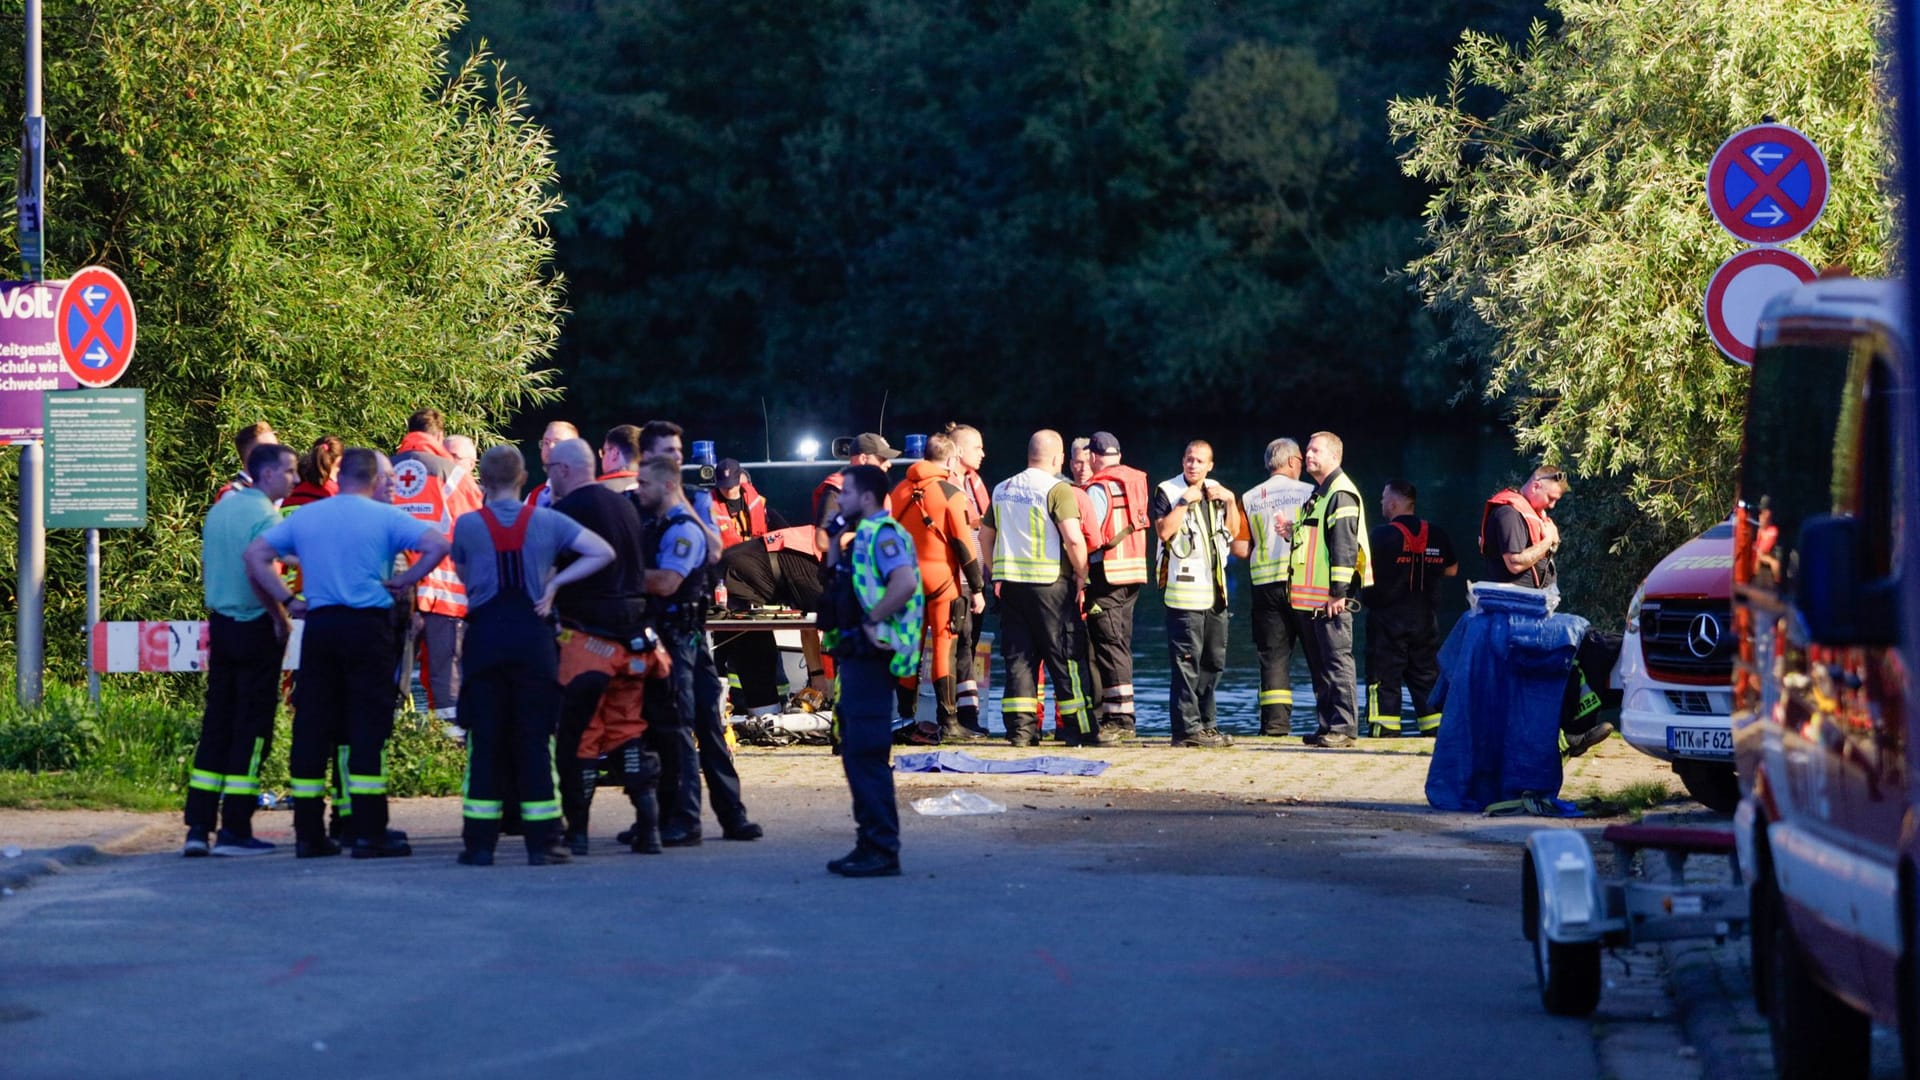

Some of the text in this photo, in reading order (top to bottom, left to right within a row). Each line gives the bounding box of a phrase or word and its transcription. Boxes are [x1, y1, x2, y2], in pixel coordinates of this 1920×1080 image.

[0, 287, 54, 319] Volt
[0, 342, 59, 359] eitgemäß
[0, 360, 37, 373] chule
[38, 359, 58, 373] wie
[0, 377, 58, 391] chweden!
[1674, 730, 1695, 748] MTK
[1703, 731, 1710, 749] F
